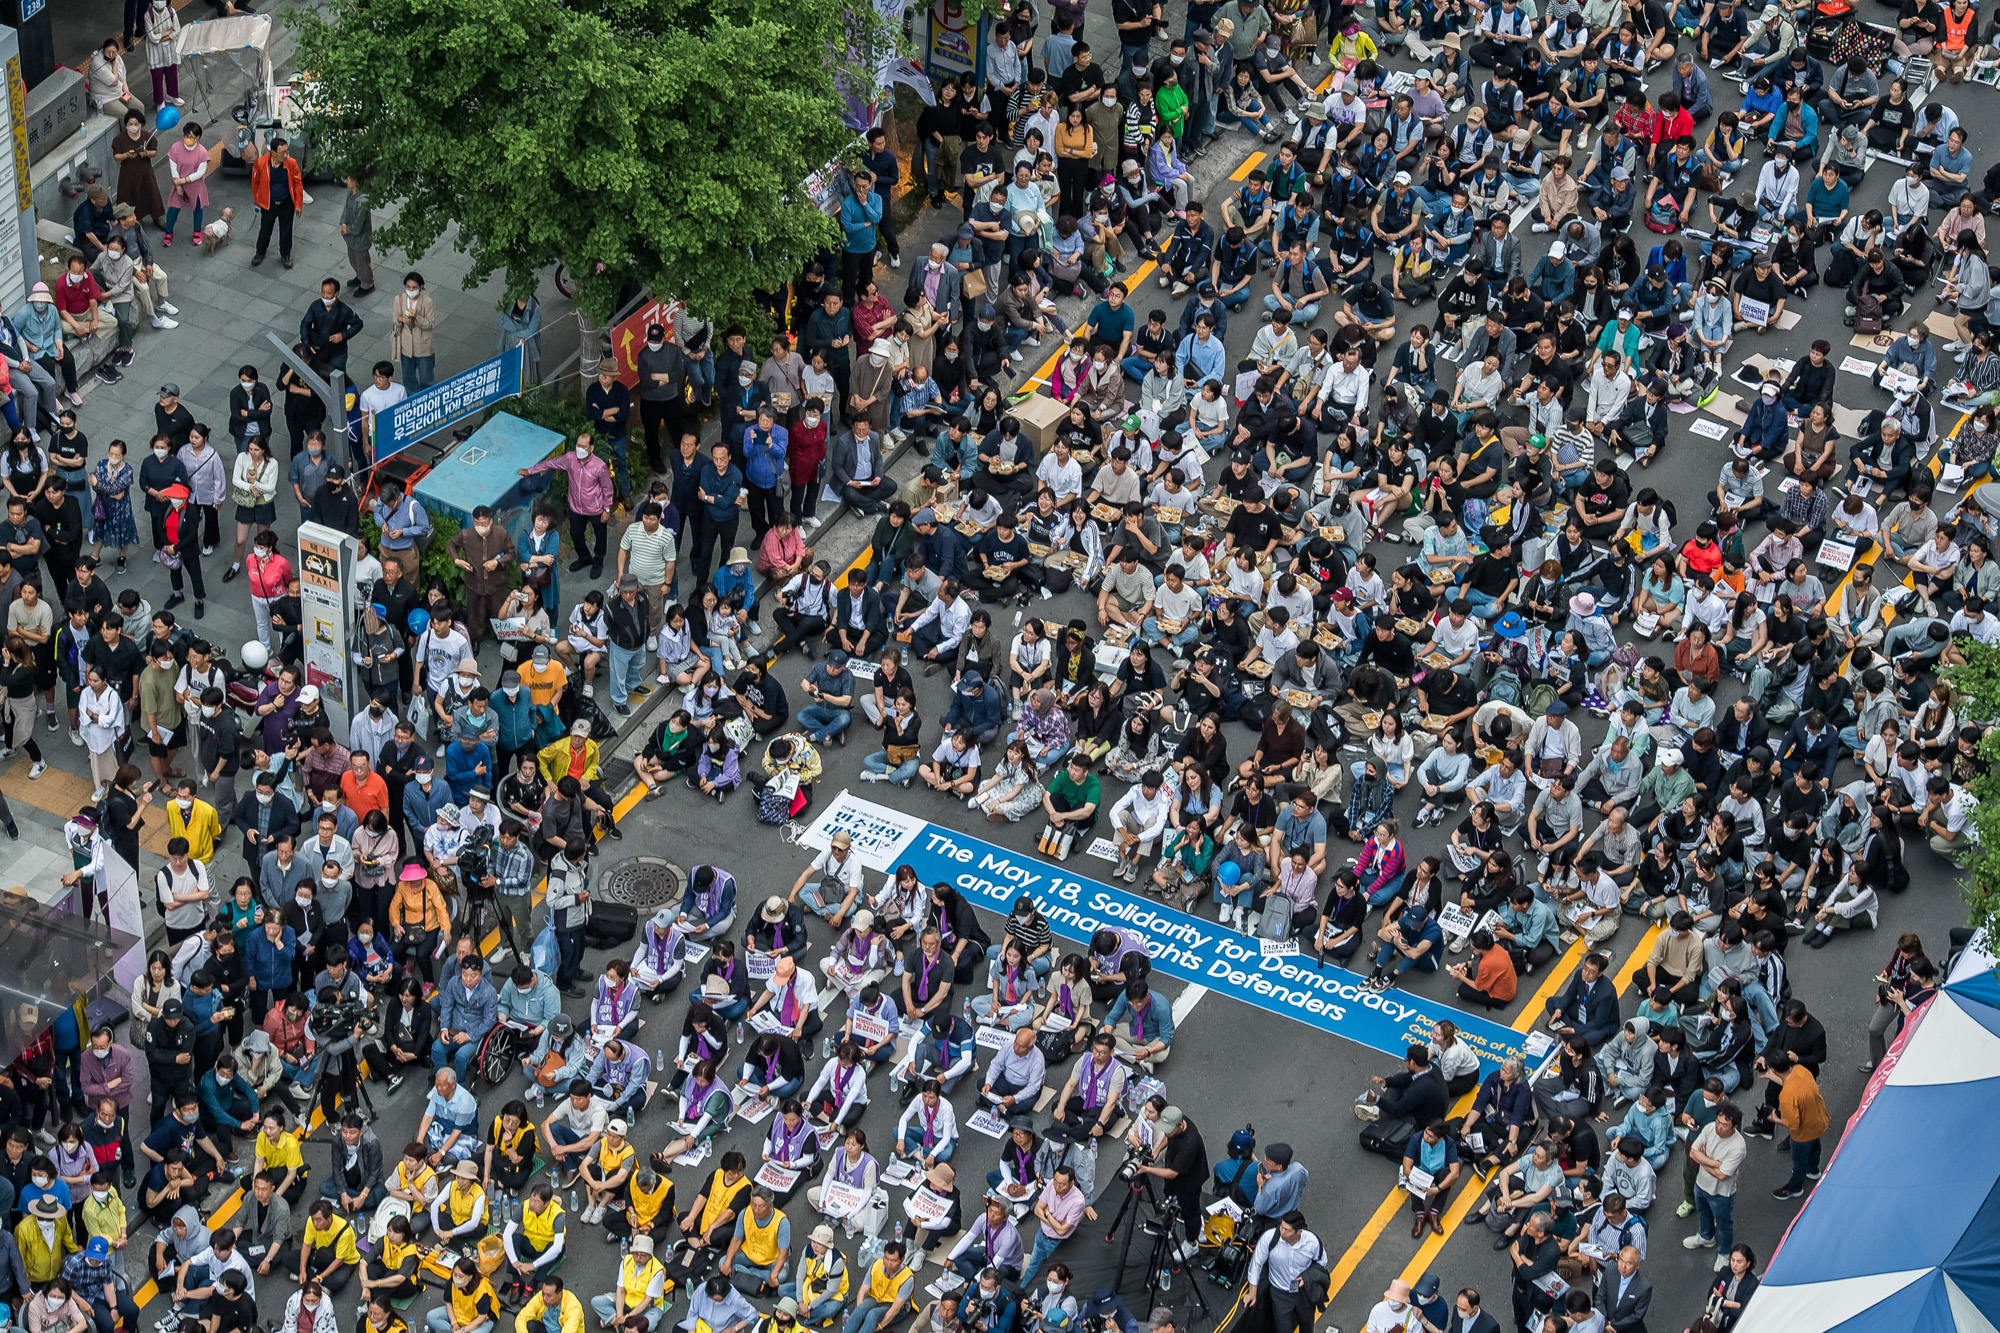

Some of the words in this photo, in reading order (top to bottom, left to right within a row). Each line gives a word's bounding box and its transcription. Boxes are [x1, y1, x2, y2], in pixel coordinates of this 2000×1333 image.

[26, 0, 42, 16] 238
[394, 395, 440, 429] 미얀마에
[442, 366, 502, 406] 민주주의를!
[394, 402, 461, 441] 우크라이나에
[463, 380, 500, 406] 평화를!
[309, 542, 330, 558] 택시
[310, 574, 332, 588] TAXI
[834, 811, 904, 842] 민주평화
[928, 832, 974, 863] The
[978, 854, 1042, 888] May
[1048, 878, 1082, 906] 18,
[1088, 892, 1214, 950] Solidarity
[1214, 938, 1258, 966] for
[1258, 953, 1418, 1022] Democracy
[956, 872, 1019, 902] and
[1206, 958, 1348, 1022] Defenders
[1490, 1042, 1507, 1052] of
[1506, 1046, 1527, 1060] the
